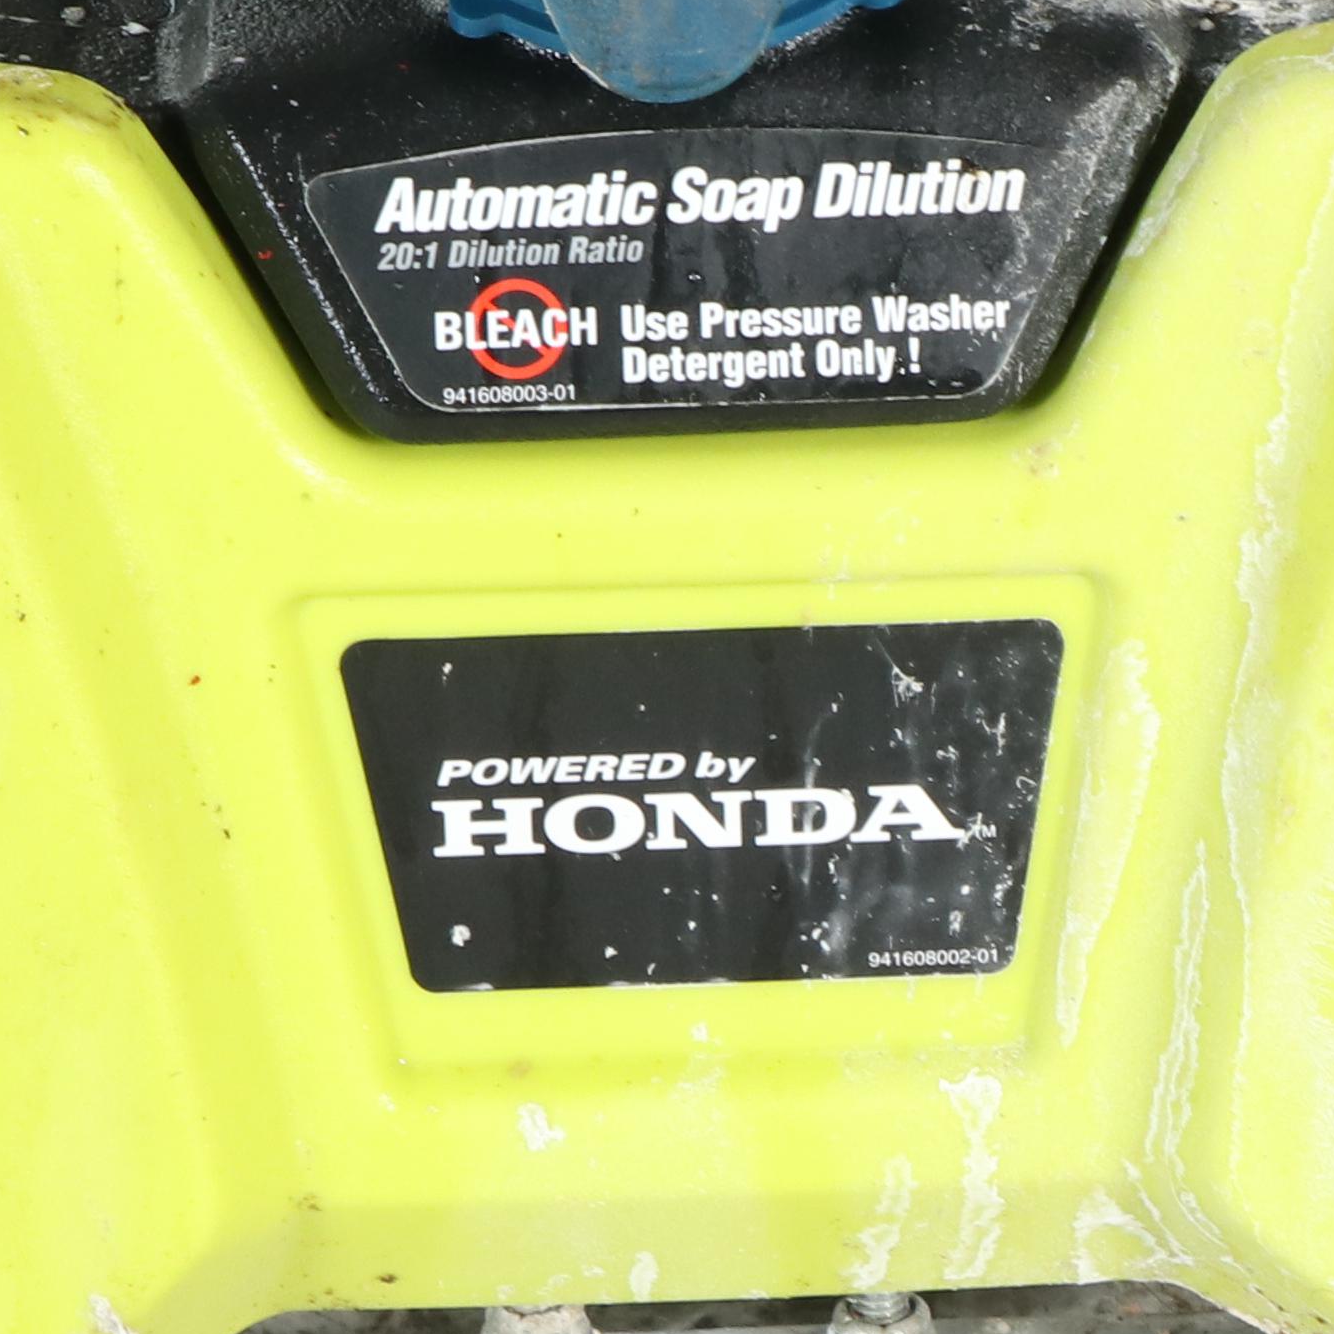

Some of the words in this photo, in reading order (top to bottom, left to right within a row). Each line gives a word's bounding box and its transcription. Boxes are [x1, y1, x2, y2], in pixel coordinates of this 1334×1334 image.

[374, 170, 657, 233] Automatic
[667, 166, 804, 232] Soap
[814, 158, 1025, 218] Dilution
[378, 241, 437, 271] 20:1
[448, 239, 560, 268] Dilution
[569, 235, 644, 264] Ratio
[434, 307, 598, 351] BLEACH
[620, 303, 689, 341] Use
[700, 301, 862, 339] Pressure
[871, 294, 1010, 332] Washer
[622, 342, 806, 387] Detergent
[443, 383, 576, 405] 941608003-01
[437, 752, 686, 787] POWERED
[694, 751, 756, 783] by
[431, 784, 967, 857] HONDA
[868, 947, 998, 968] 941608002-01
